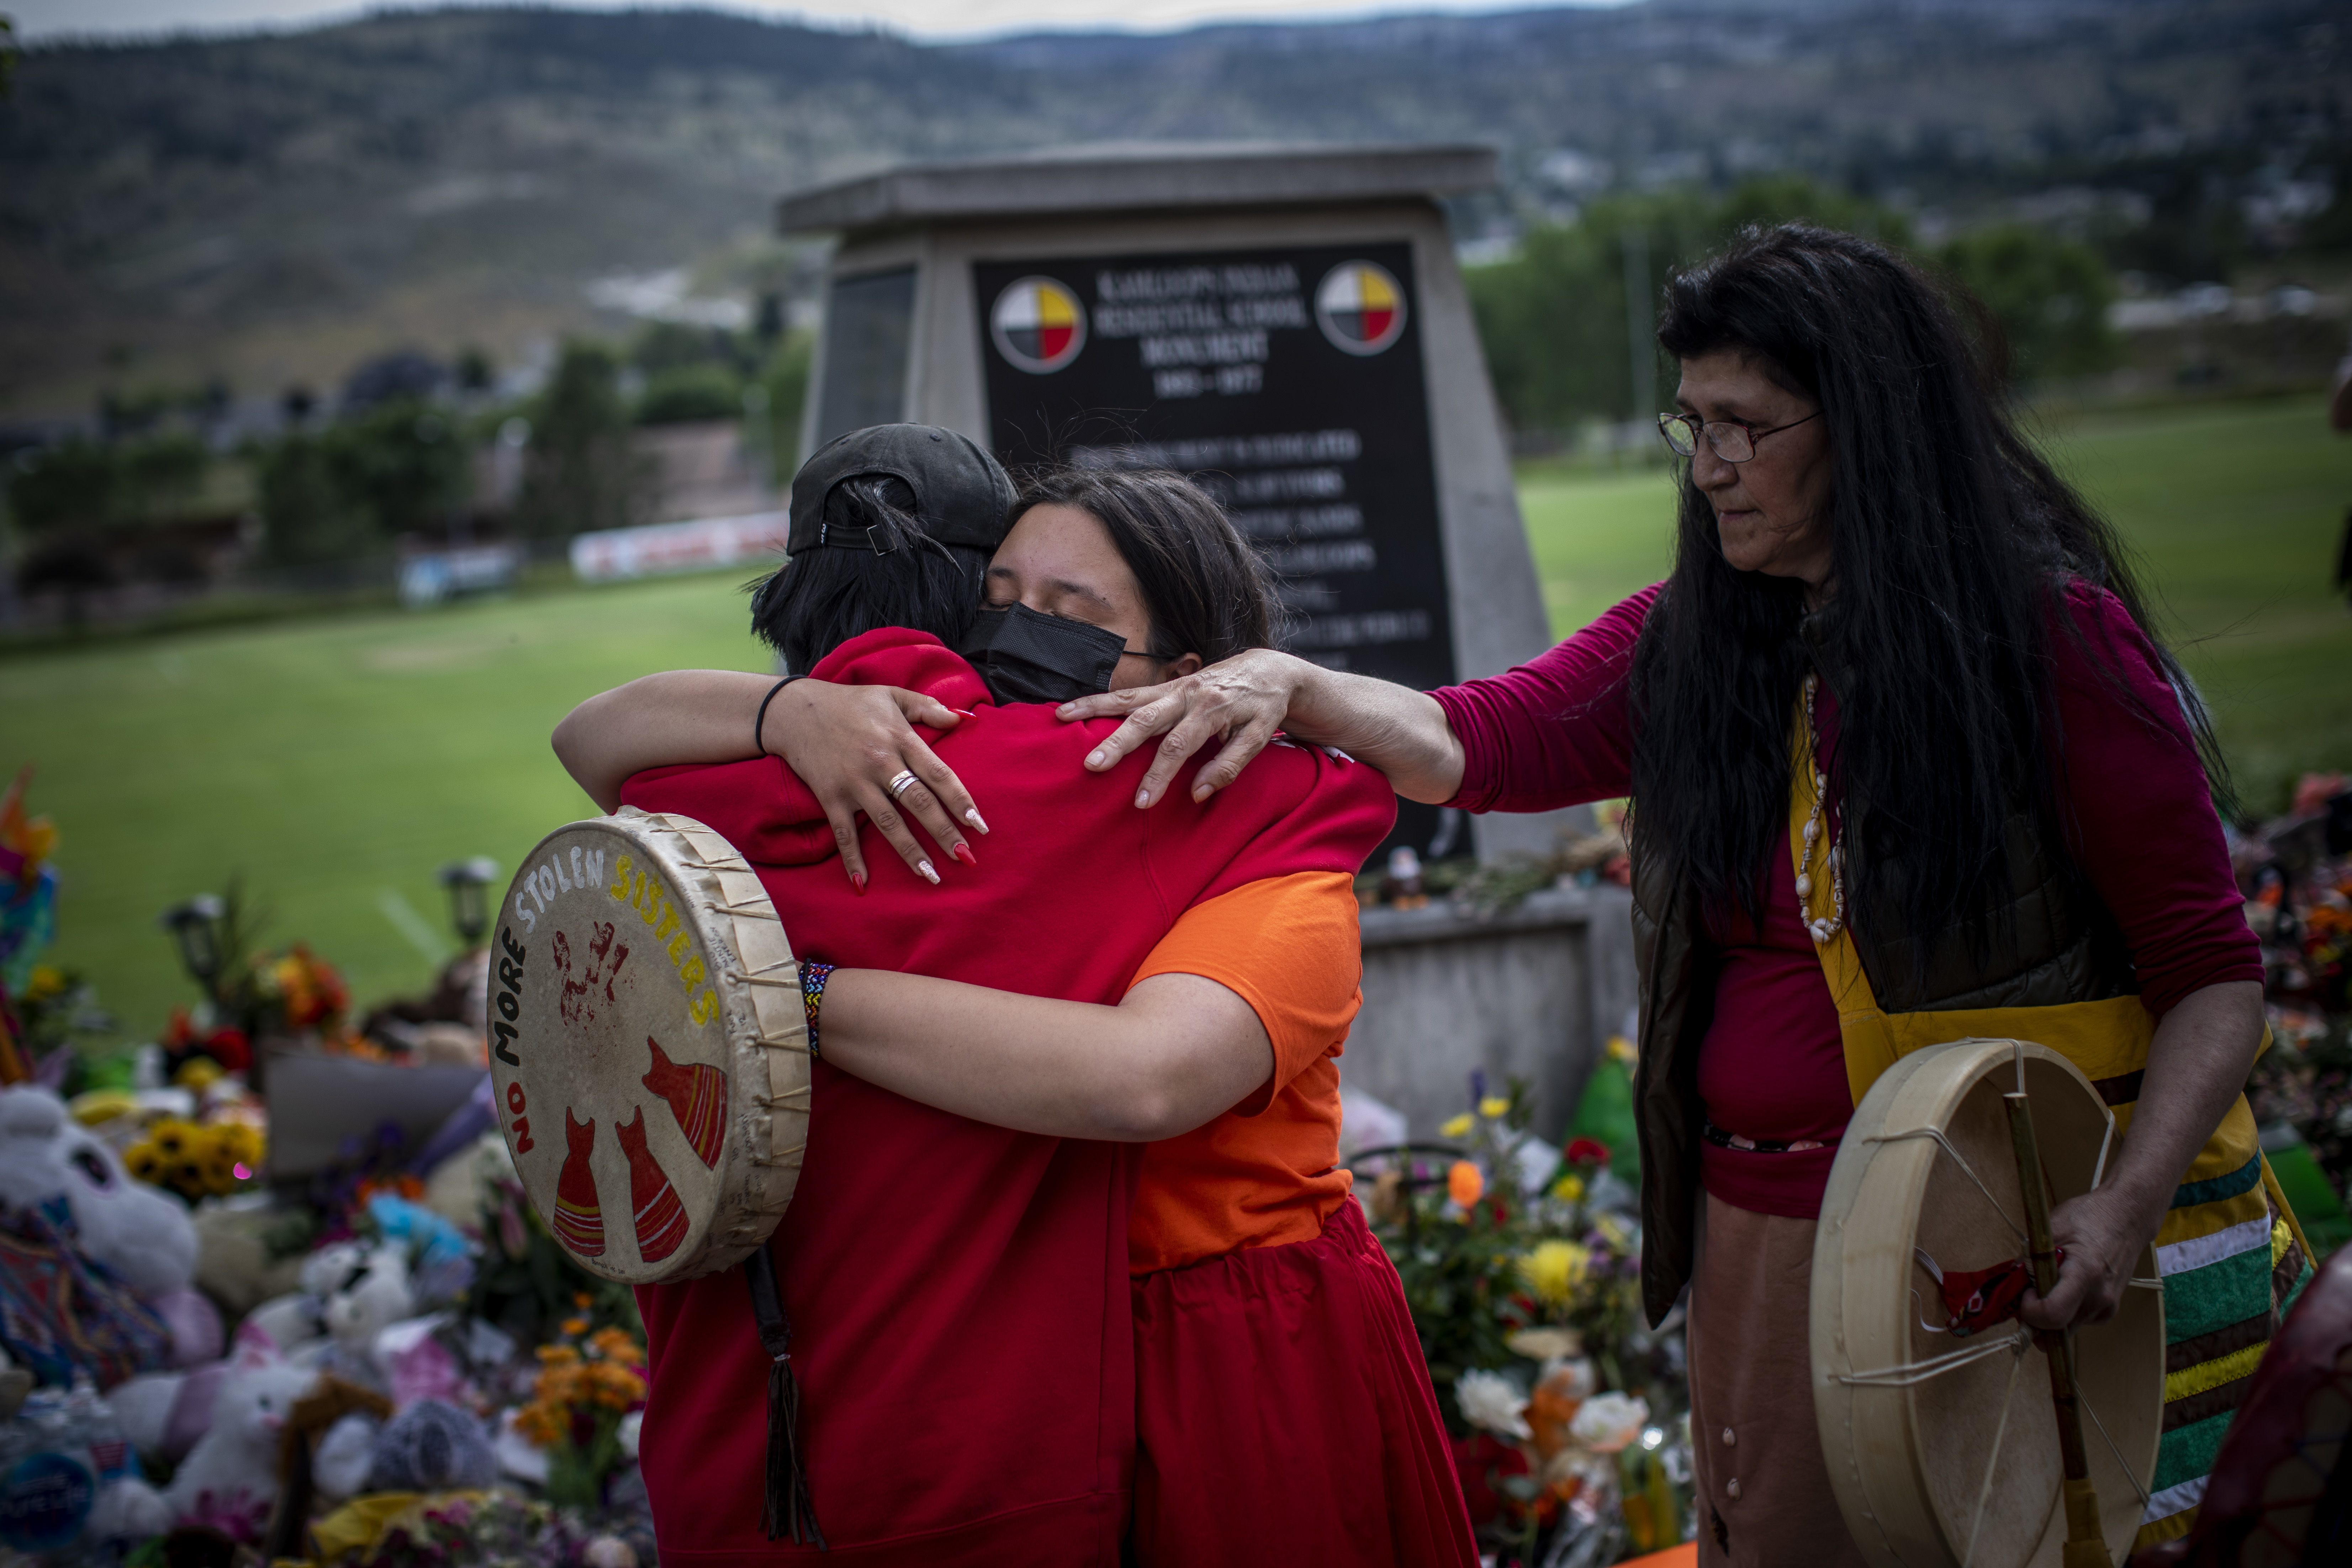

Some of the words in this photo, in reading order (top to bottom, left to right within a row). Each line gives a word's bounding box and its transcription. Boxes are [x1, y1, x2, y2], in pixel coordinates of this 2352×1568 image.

[516, 846, 604, 934] STOLEN
[611, 855, 720, 1026] SISTERS
[708, 936, 730, 968] AUNTIE
[495, 926, 526, 1067] MORE
[507, 1082, 534, 1154] NO
